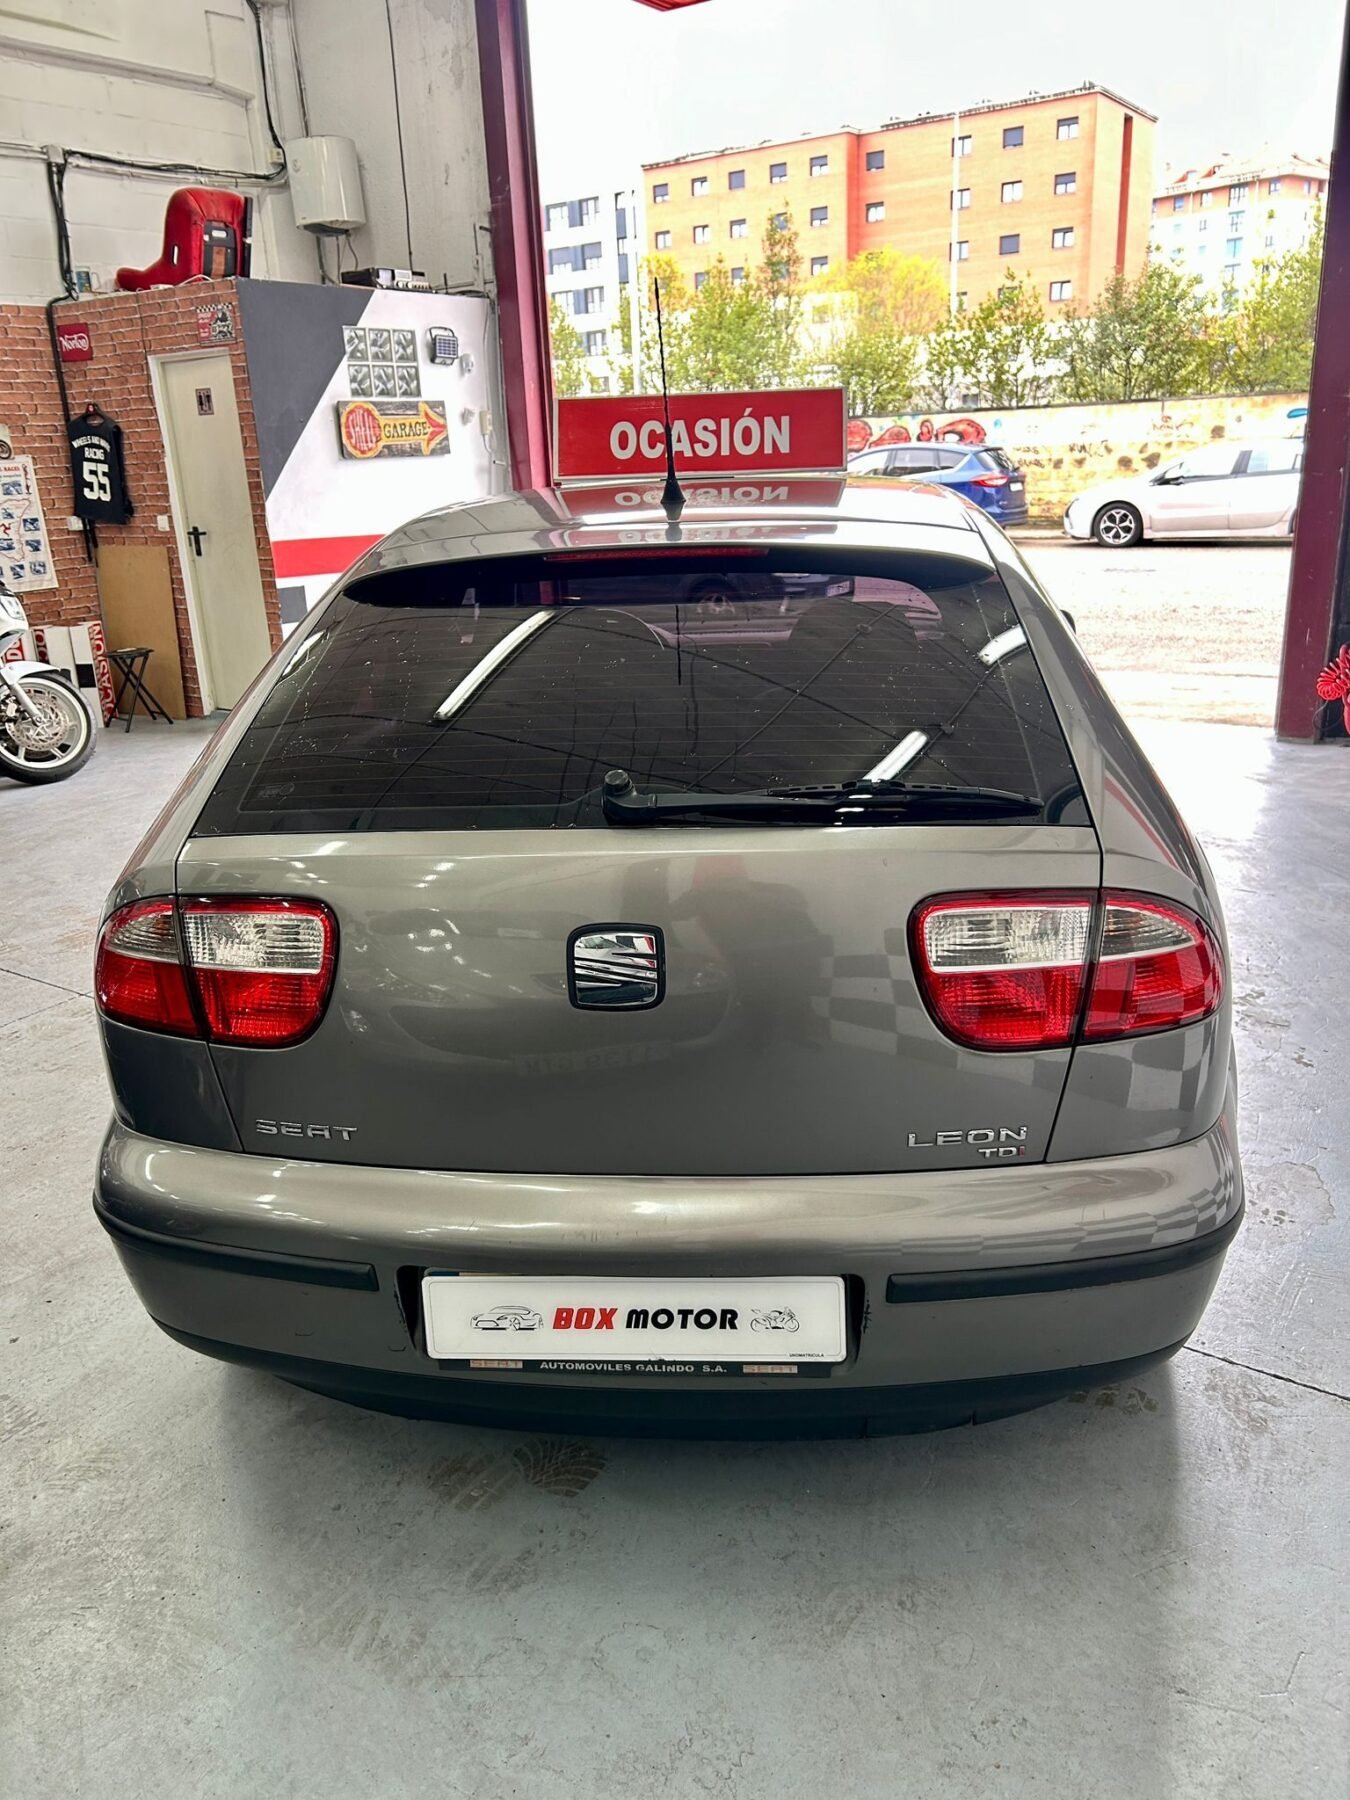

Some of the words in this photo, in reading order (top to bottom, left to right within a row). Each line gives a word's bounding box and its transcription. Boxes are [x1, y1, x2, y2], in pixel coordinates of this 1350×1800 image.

[383, 421, 428, 439] GARAGE
[609, 407, 790, 460] OCASIÓN
[82, 461, 112, 502] 55
[255, 1119, 358, 1141] SEAT
[907, 1126, 1028, 1148] LEON
[552, 1307, 619, 1330] BOX
[625, 1308, 739, 1330] MOTOR
[539, 1361, 632, 1371] AUTOMOVILES
[635, 1363, 695, 1373] GALINDO
[702, 1364, 728, 1373] S.A.
